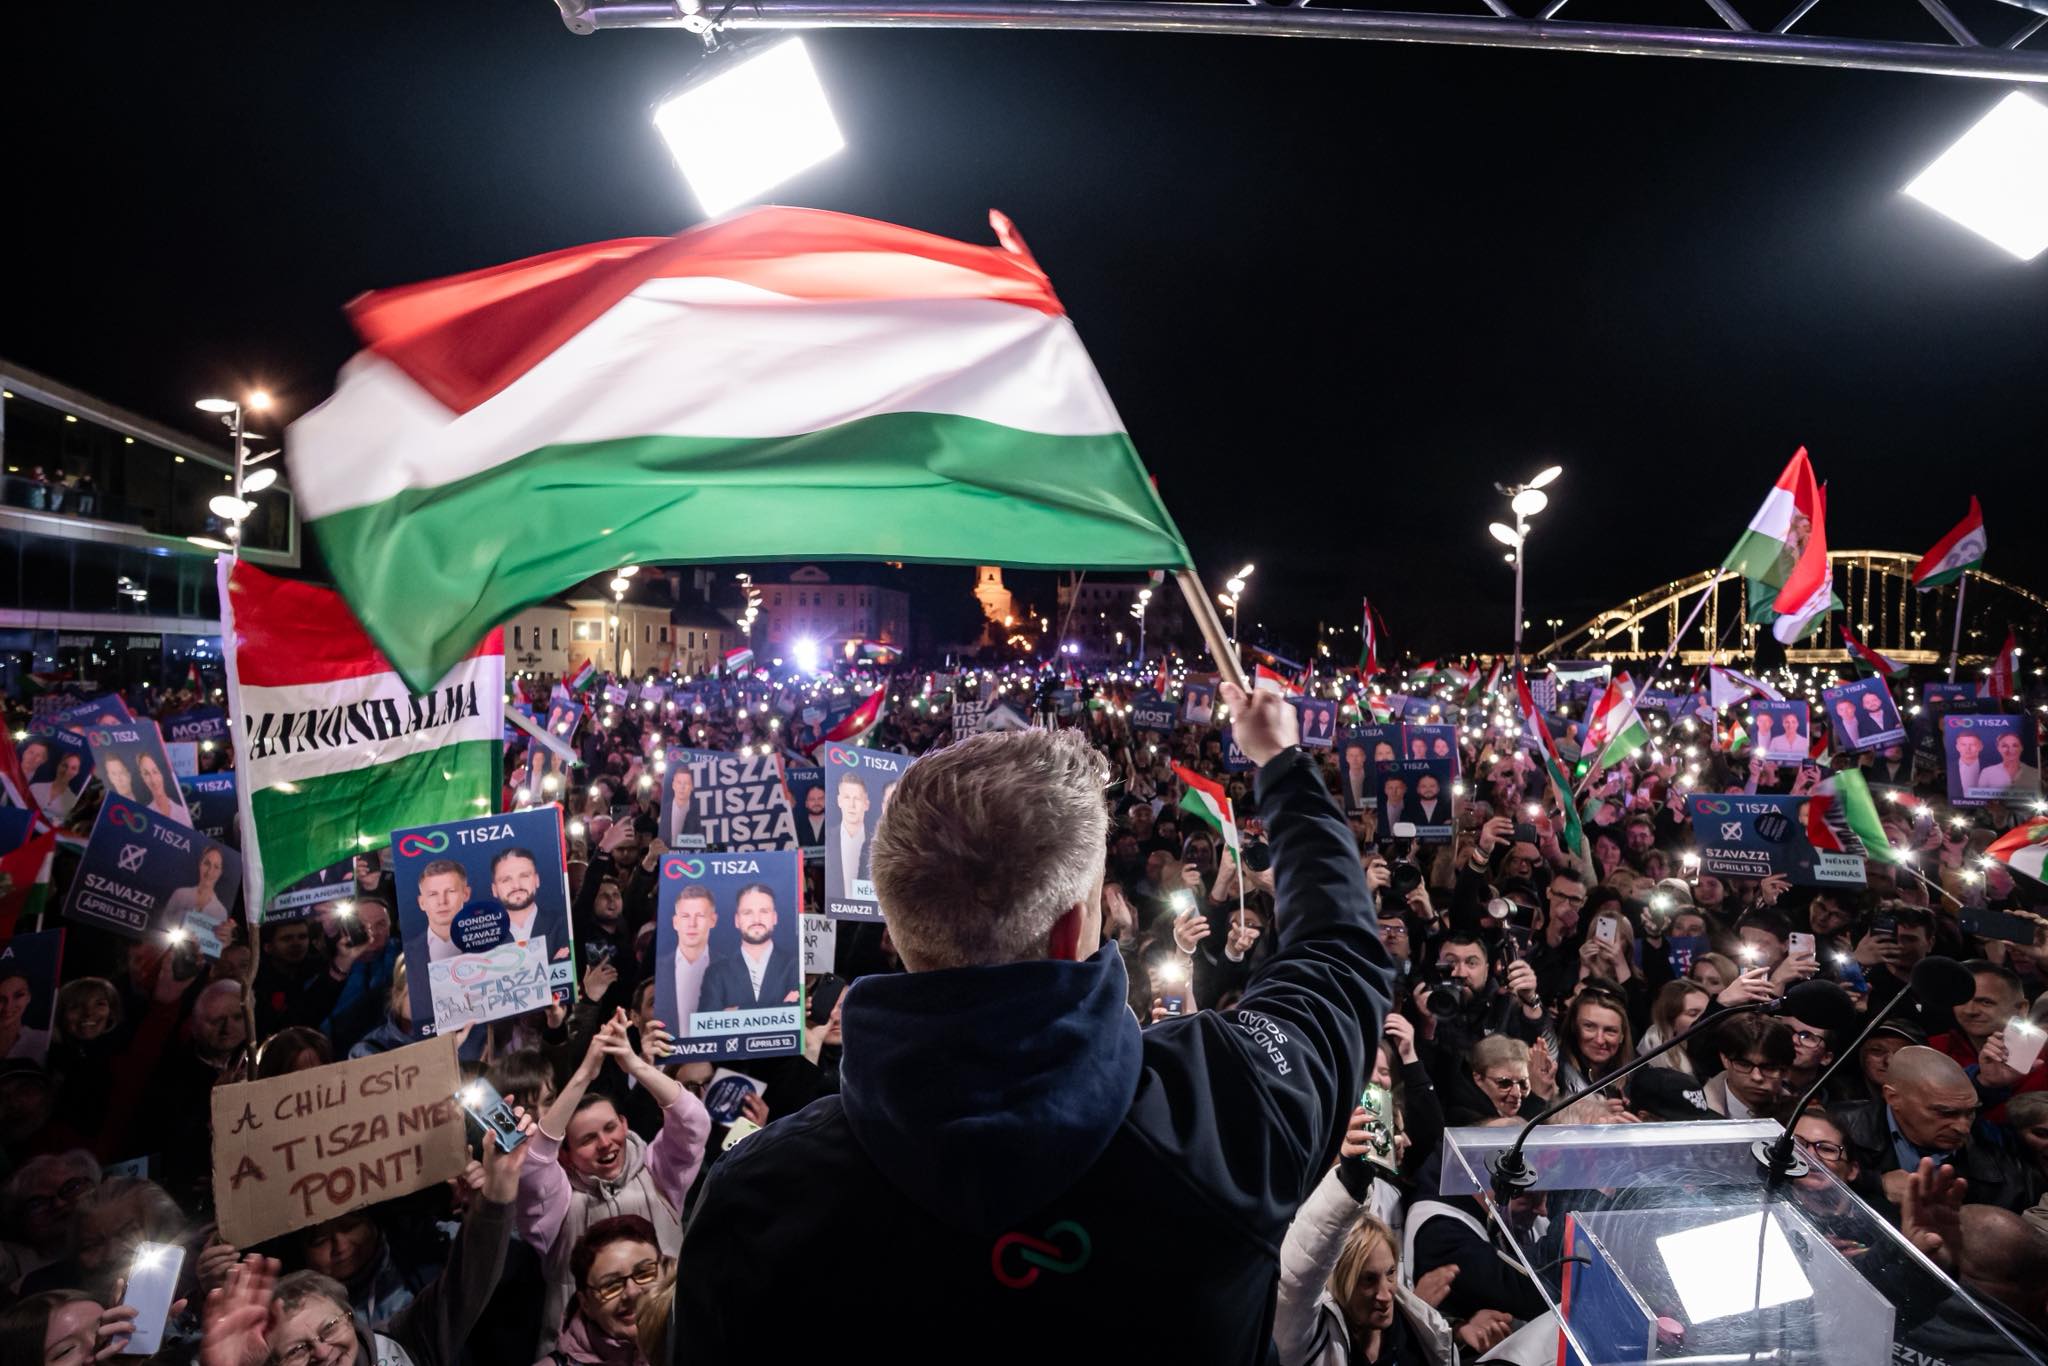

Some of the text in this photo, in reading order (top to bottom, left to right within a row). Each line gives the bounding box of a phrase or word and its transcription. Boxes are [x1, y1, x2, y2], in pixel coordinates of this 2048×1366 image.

[1844, 683, 1867, 694] TISZA
[73, 704, 100, 716] TISZA
[1133, 709, 1172, 723] MOST
[172, 717, 222, 738] MOST
[1978, 719, 2010, 727] TISZA
[57, 730, 83, 746] TISZA
[112, 730, 140, 743] TISZA
[1360, 728, 1384, 737] TISZA
[688, 752, 781, 788] TISZA
[864, 755, 898, 773] TISZA
[793, 771, 819, 781] TISZA
[196, 780, 233, 792] TISZA
[694, 783, 789, 816] TISZA
[1736, 802, 1782, 814] TISZA
[457, 823, 515, 846] TISZA
[701, 812, 796, 844] TISZA
[152, 823, 192, 853] TISZA
[1705, 848, 1770, 861] SZAVAZZ!
[1825, 855, 1859, 865] NÉHER
[711, 860, 760, 875] TISZA
[1713, 861, 1752, 873] ÁPRILIS
[1820, 868, 1861, 878] ANDRÁS
[84, 873, 155, 908] SZAVAZZ!
[857, 885, 877, 896] NÉH
[83, 896, 127, 918] ÁPRILIS
[831, 902, 872, 915] SZAVAZZ!
[264, 910, 296, 922] AVAZZ!
[458, 911, 502, 928] GONDOLJ
[804, 919, 832, 932] YUNK
[462, 927, 501, 942] SZAVAZZ
[697, 1011, 795, 1030] NÉHER ANDRÁS
[1238, 1010, 1288, 1044] SQUAD
[672, 1042, 717, 1055] AVAZZ!
[750, 1038, 781, 1048] ÁPRILIS
[231, 1103, 263, 1134] A
[230, 1156, 266, 1190] A
[273, 1115, 388, 1171] TISZA
[290, 1145, 424, 1218] PONT!
